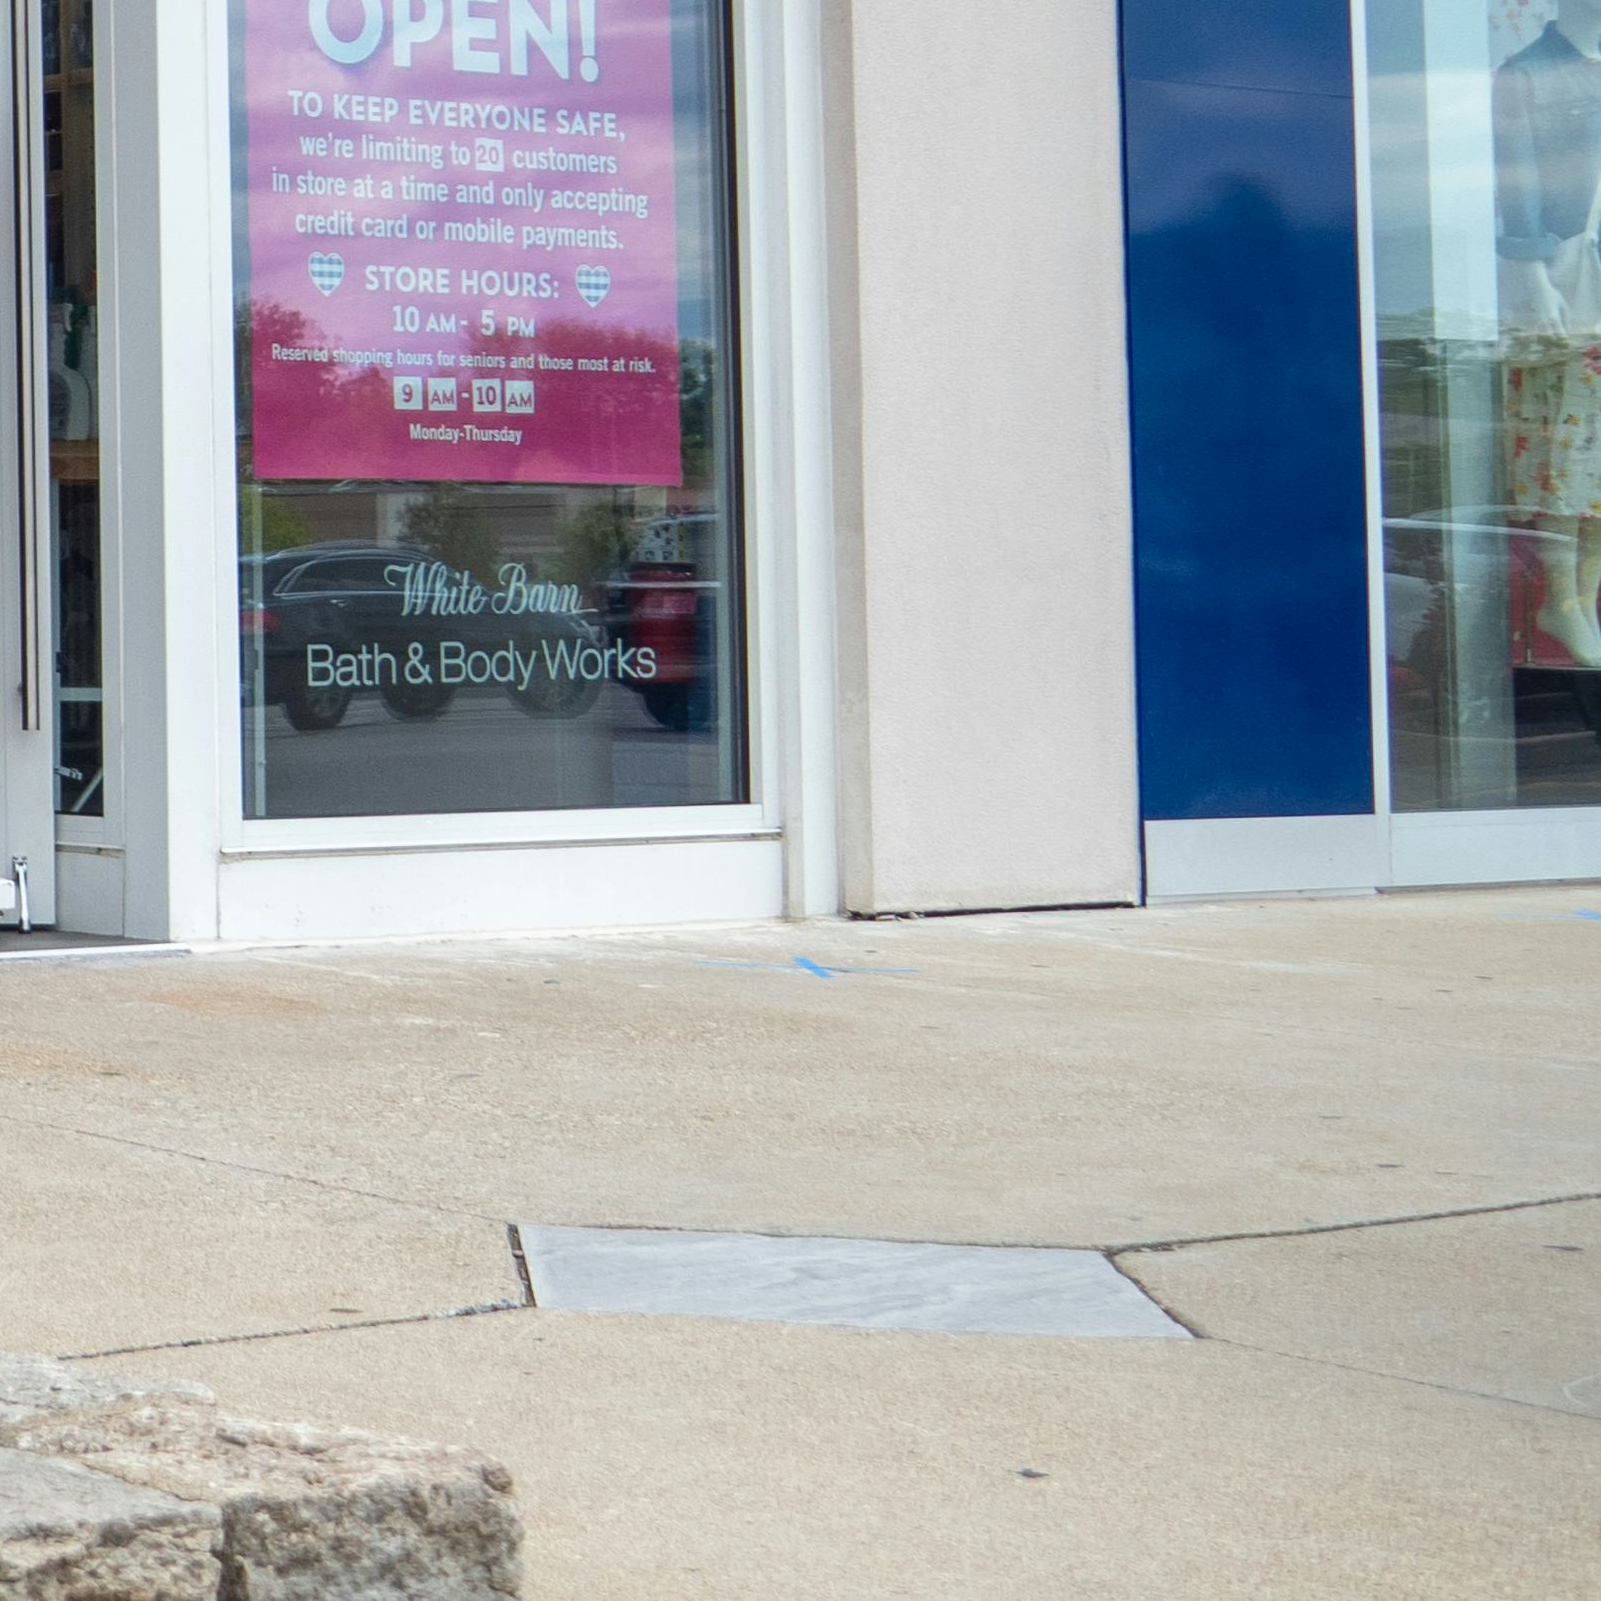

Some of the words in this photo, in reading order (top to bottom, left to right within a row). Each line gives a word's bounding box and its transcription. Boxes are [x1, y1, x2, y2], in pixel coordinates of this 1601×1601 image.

[287, 90, 322, 117] TO
[333, 94, 398, 122] KEEP
[409, 100, 547, 132] EVERYONE
[556, 110, 625, 141] SAFE,
[365, 265, 449, 293] STORE
[461, 270, 559, 298] HOURS:
[393, 306, 419, 332] 10
[426, 313, 455, 332] AM
[481, 310, 495, 335] 5
[507, 316, 534, 337] PM
[401, 383, 412, 404] 9
[431, 388, 455, 407] AM
[476, 386, 496, 407] 10
[508, 391, 531, 409] AM
[409, 424, 522, 445] Monday-Thursday
[384, 563, 486, 616] White
[492, 562, 589, 614] Barn
[307, 643, 395, 686] Bath
[404, 641, 432, 683] &
[440, 640, 537, 689] Body
[541, 637, 656, 679] Works
